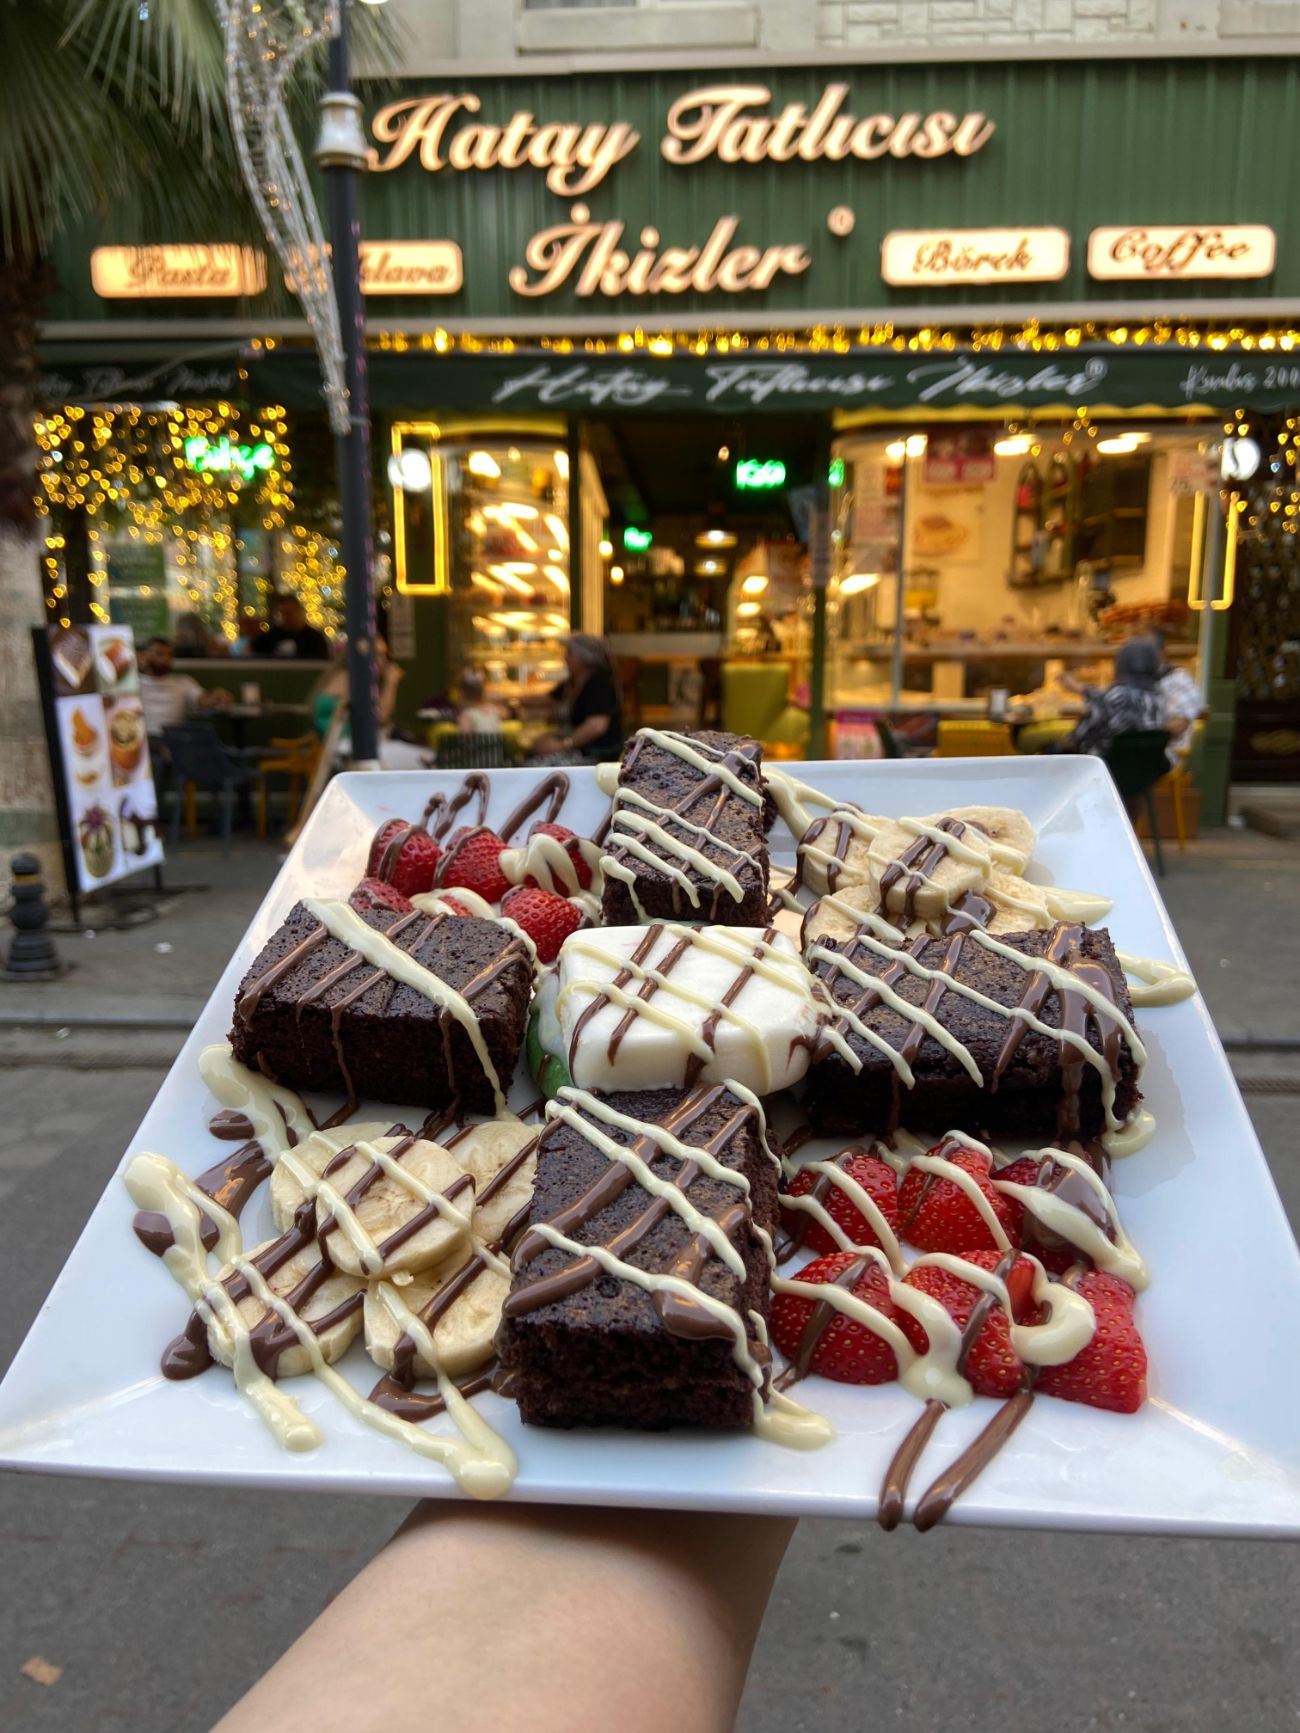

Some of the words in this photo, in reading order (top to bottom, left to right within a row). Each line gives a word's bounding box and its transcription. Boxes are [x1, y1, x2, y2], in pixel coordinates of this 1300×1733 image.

[364, 92, 641, 198] Hatay
[660, 81, 997, 165] Tatlıcısı
[508, 202, 813, 298] İkizler
[912, 236, 1033, 274] Börek
[1109, 228, 1253, 274] Coffee
